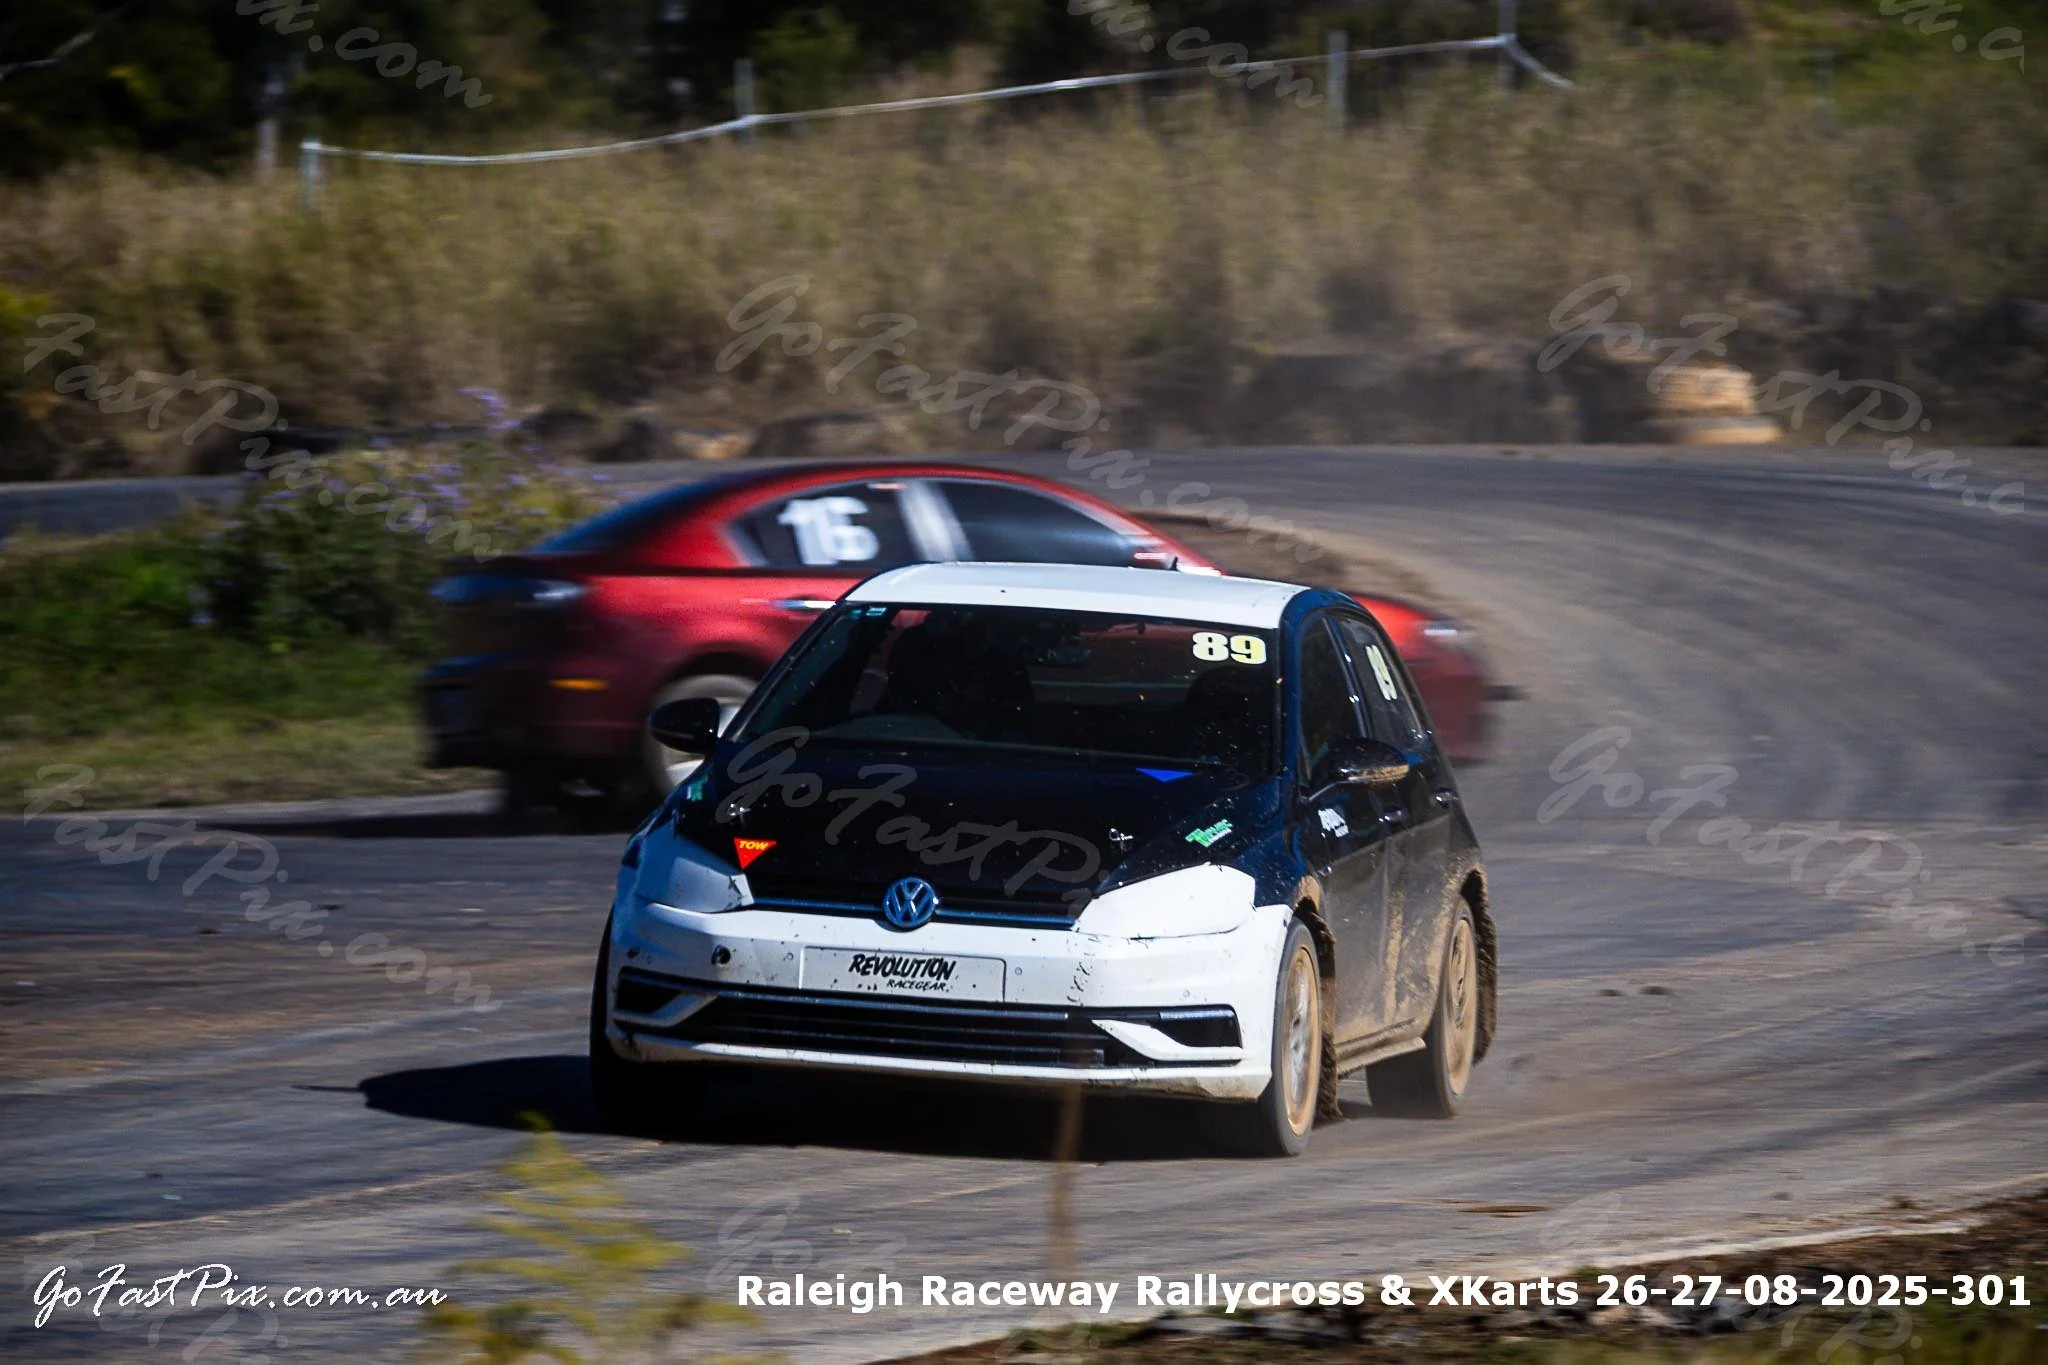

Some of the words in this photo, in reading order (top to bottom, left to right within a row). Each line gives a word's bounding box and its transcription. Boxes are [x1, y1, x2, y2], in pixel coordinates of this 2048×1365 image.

[776, 496, 881, 566] 16
[1192, 631, 1267, 665] 89
[739, 840, 769, 850] TOW
[848, 953, 956, 981] REVOLUTION
[886, 979, 947, 992] RACEGEAR
